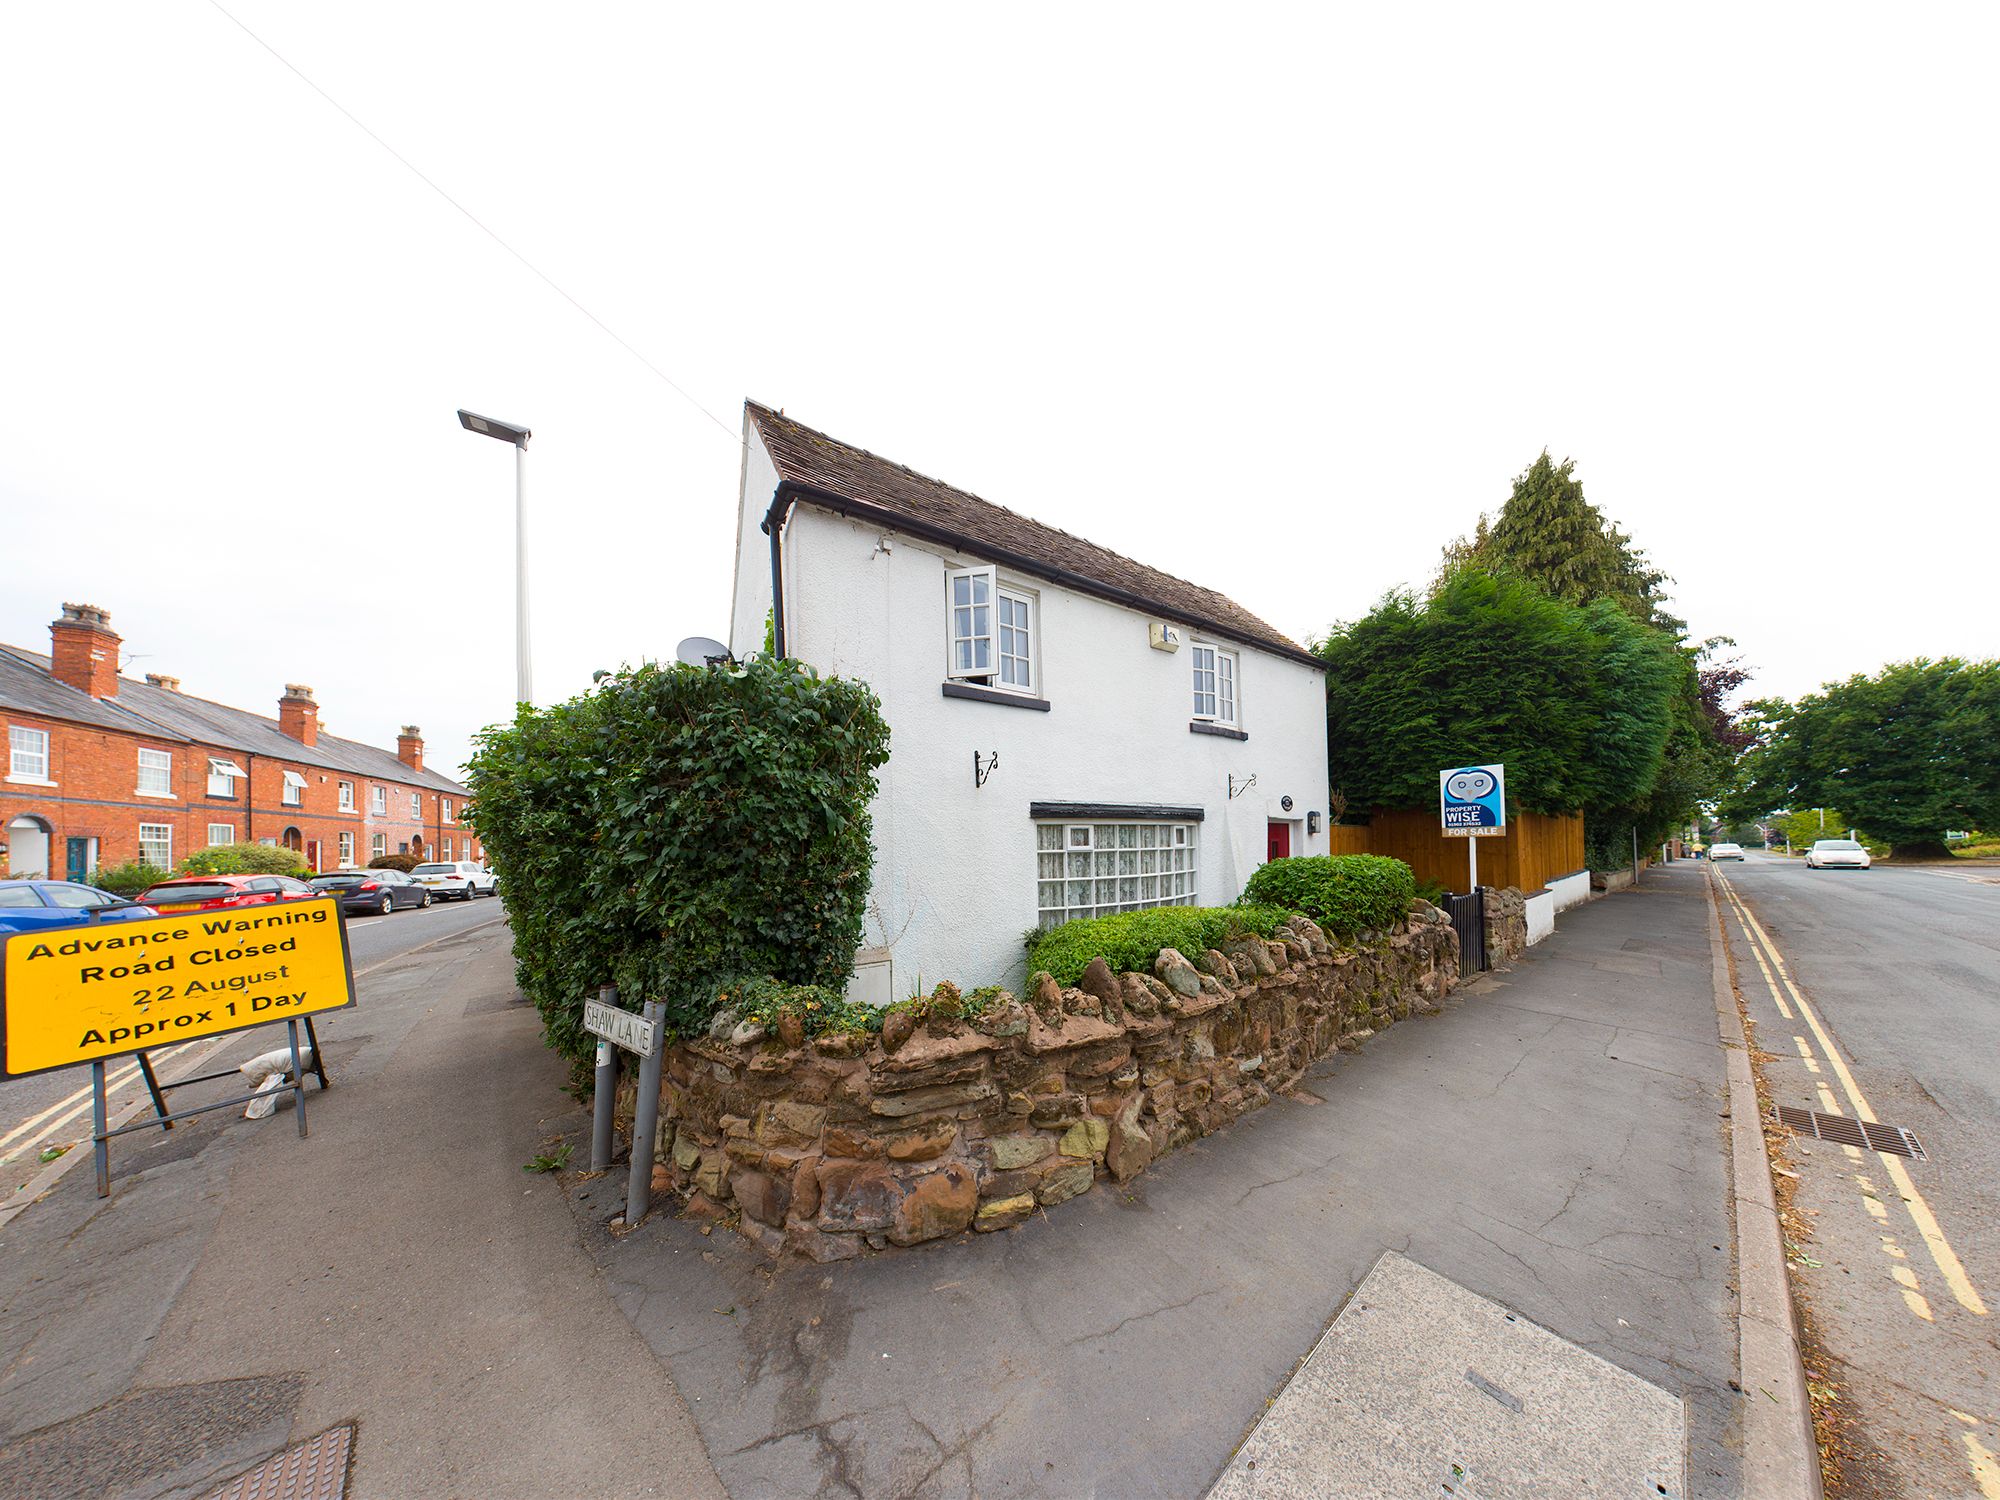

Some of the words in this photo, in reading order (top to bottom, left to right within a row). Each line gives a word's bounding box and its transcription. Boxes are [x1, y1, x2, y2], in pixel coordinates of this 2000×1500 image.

[1446, 805, 1481, 813] PROPERTY
[1446, 812, 1480, 822] WISE
[1448, 828, 1467, 836] FOR
[1470, 827, 1498, 836] SALE
[26, 929, 189, 961] Advance
[202, 910, 327, 936] Warning
[80, 955, 175, 984] Road
[189, 937, 296, 965] Closed
[132, 985, 176, 1006] 22
[183, 965, 290, 996] August
[79, 1010, 213, 1048] Approx
[225, 1002, 236, 1017] 1
[251, 991, 307, 1012] Day
[586, 1005, 615, 1034] SHAW
[618, 1017, 649, 1051] LANE
